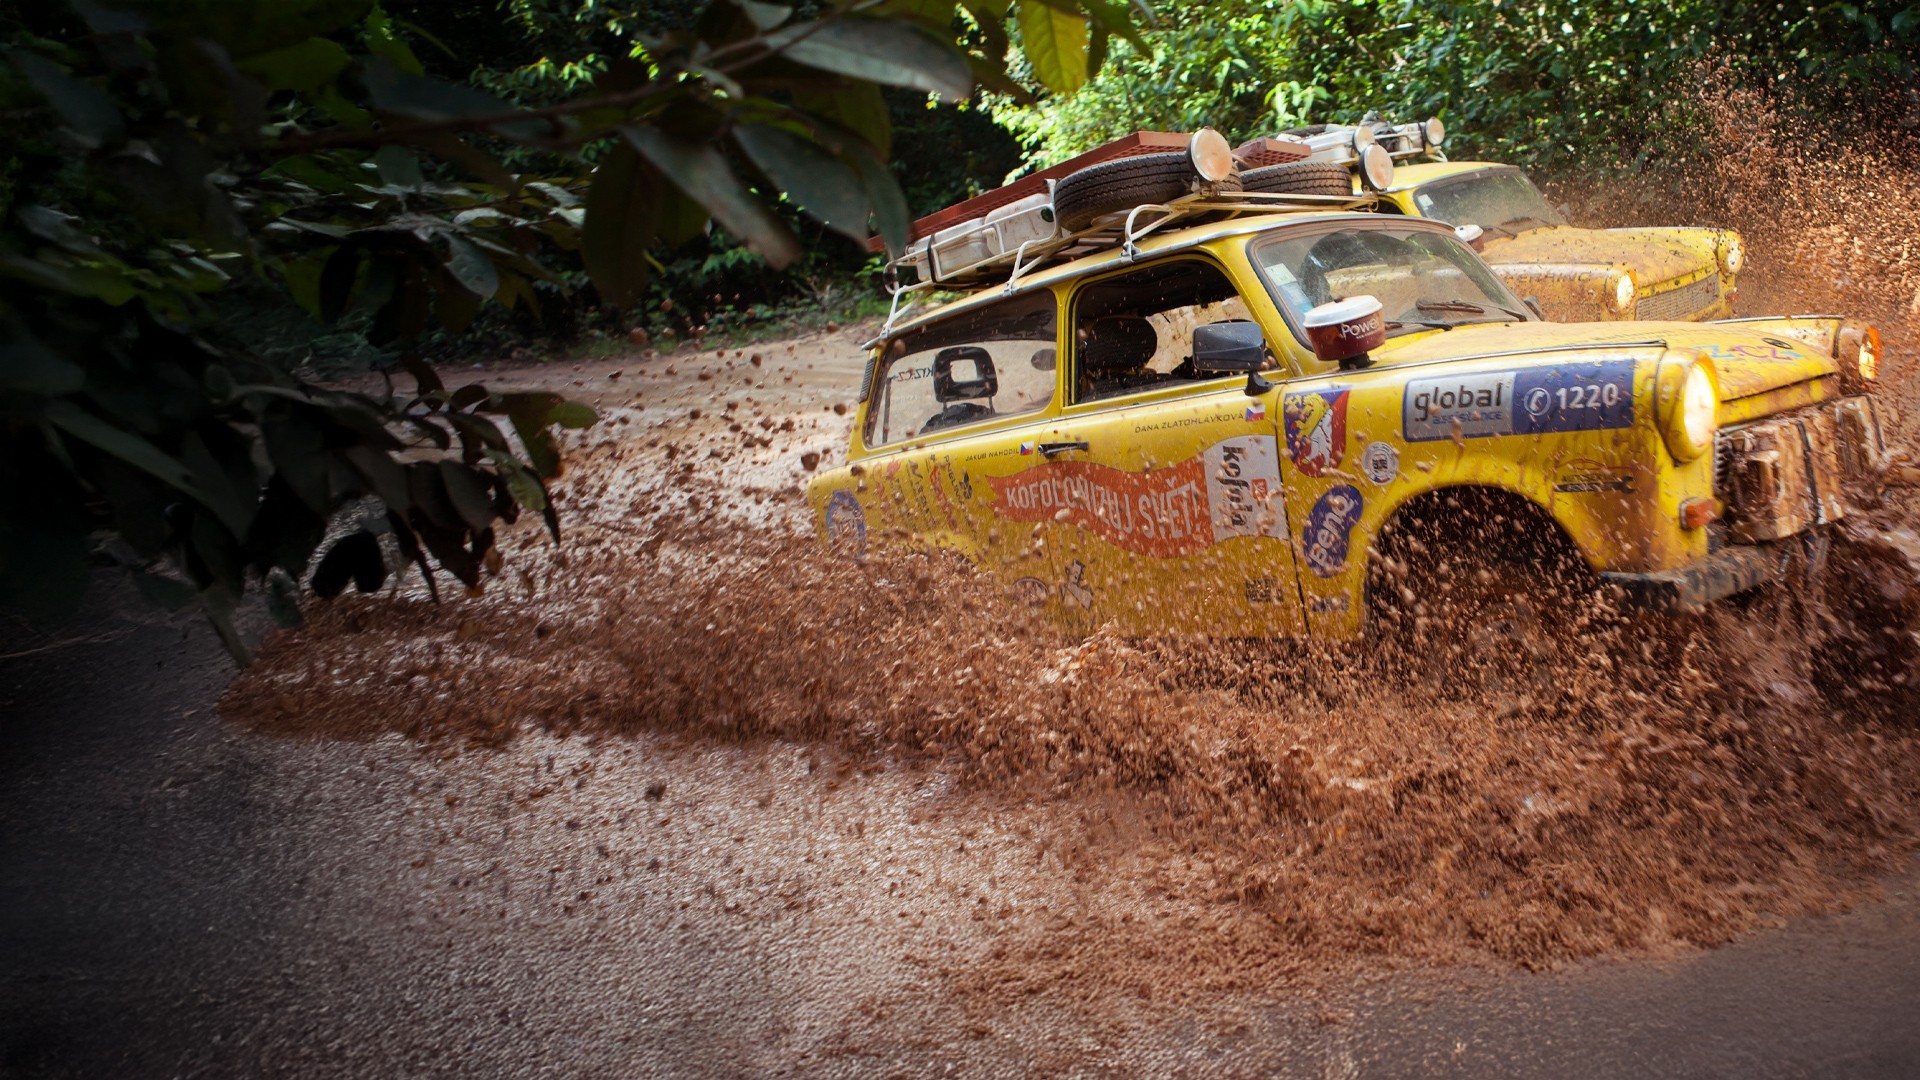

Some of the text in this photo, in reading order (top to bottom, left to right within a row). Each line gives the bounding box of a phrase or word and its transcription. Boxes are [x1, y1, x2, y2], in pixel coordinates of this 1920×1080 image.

[1341, 317, 1380, 340] Powe
[1414, 382, 1503, 422] global
[1556, 383, 1619, 410] 1220
[1134, 424, 1159, 434] DANA
[1432, 411, 1503, 424] assstnce
[965, 454, 987, 462] JAKUB
[1005, 476, 1133, 534] KOFOLONIZUJ
[1138, 475, 1201, 539] SVĚT!
